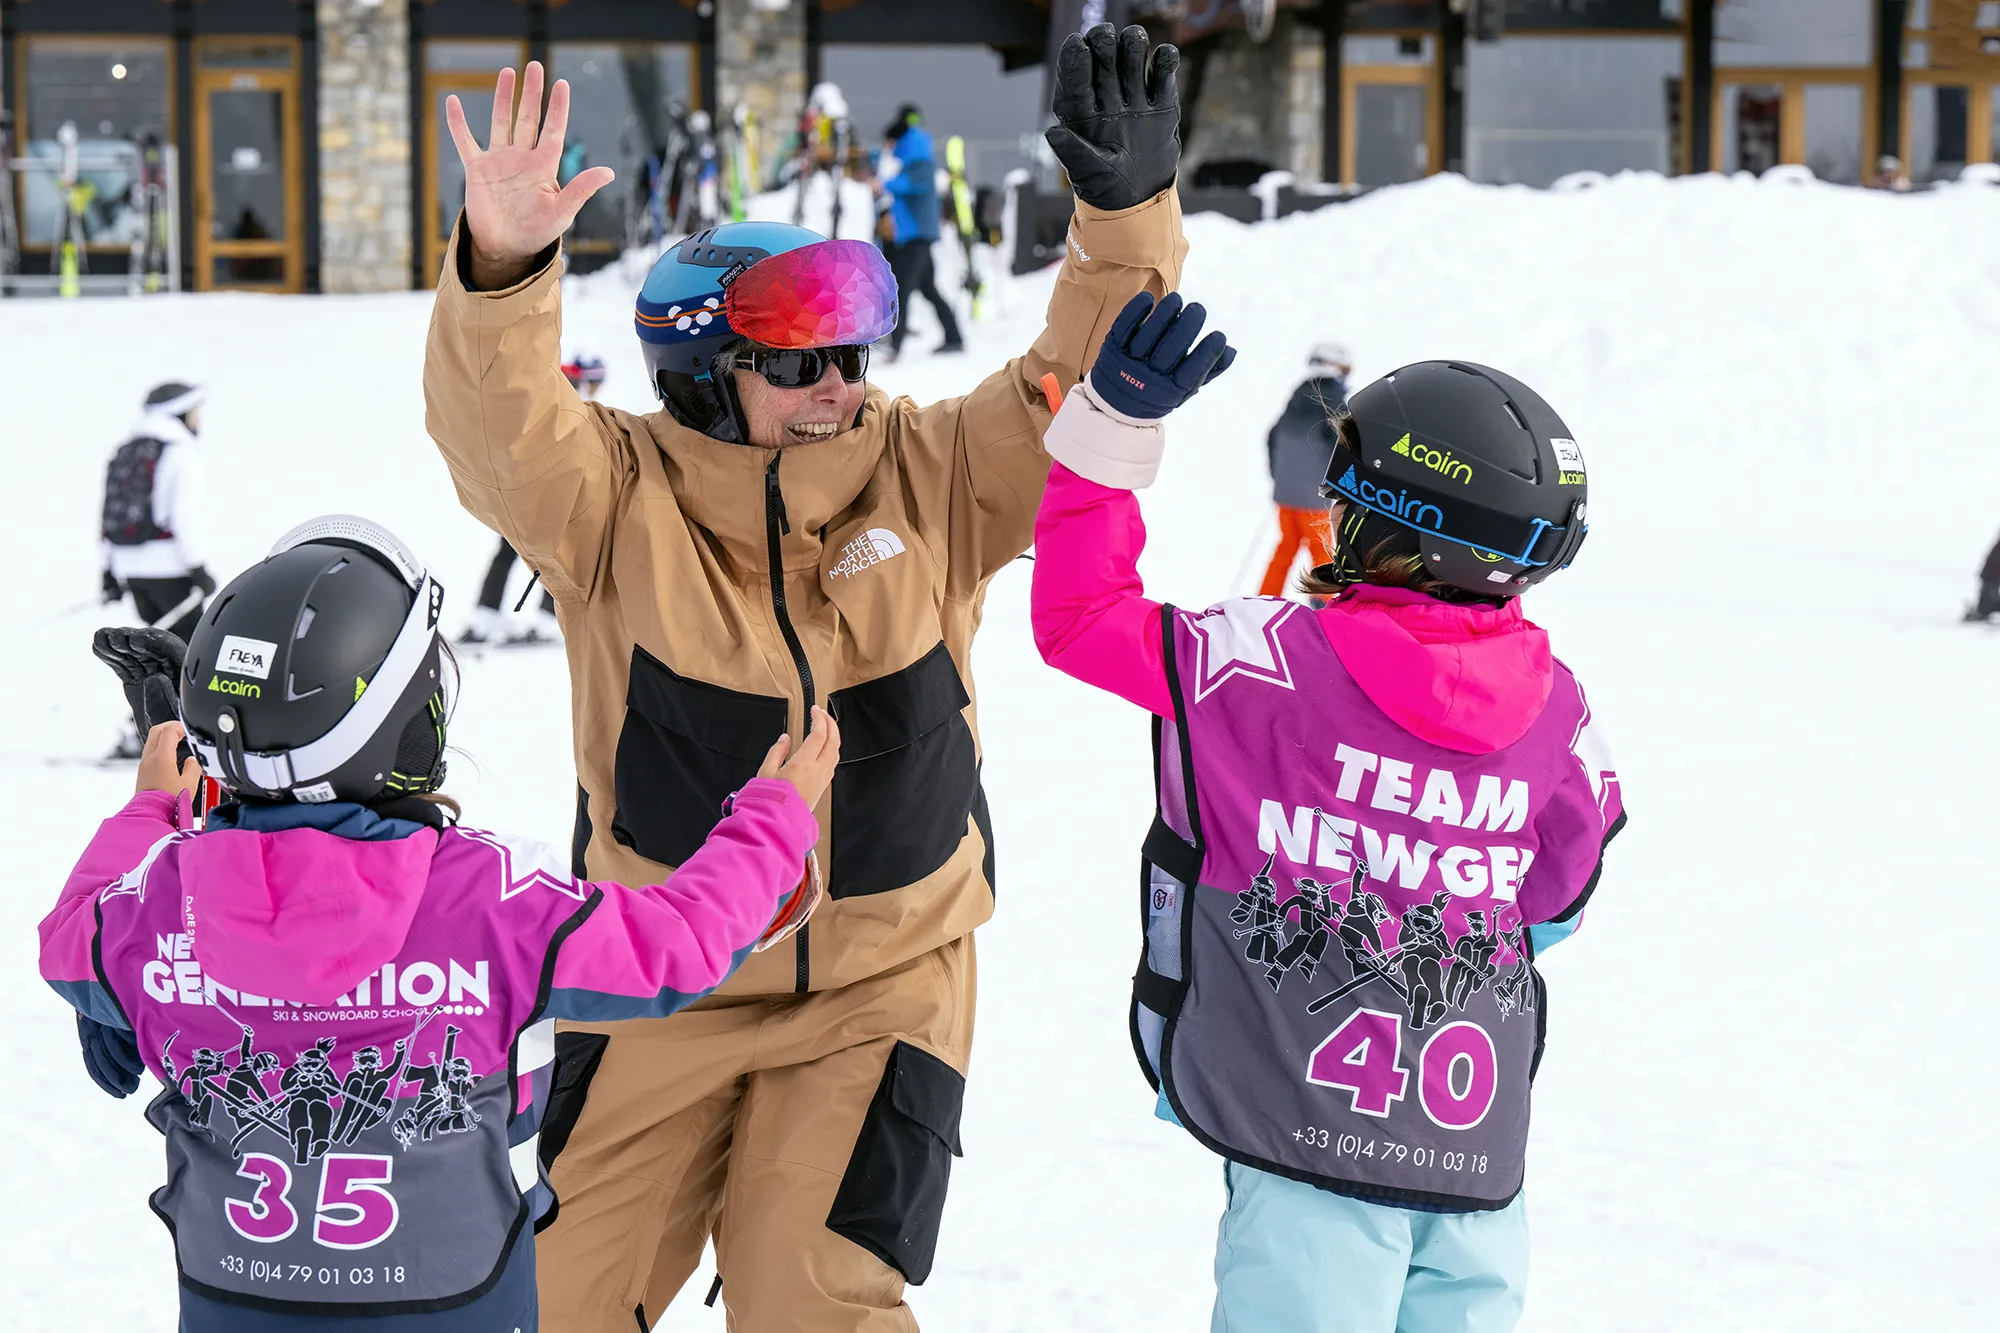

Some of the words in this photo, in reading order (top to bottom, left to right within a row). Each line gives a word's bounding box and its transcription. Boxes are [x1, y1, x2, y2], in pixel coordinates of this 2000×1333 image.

[1120, 370, 1145, 390] WEDZE
[1411, 444, 1473, 485] cairn
[1359, 480, 1444, 530] cairn
[828, 542, 875, 580] NORTH
[841, 533, 869, 555] THE
[843, 553, 880, 579] FACE
[229, 648, 264, 669] FREYA
[220, 679, 261, 699] cairn
[1333, 742, 1529, 833] TEAM
[156, 932, 193, 962] NE
[142, 957, 490, 1008] GENTION
[273, 1010, 289, 1021] SKI
[291, 1011, 300, 1021] &
[302, 1009, 379, 1022] SNOWBOARD
[382, 1007, 430, 1019] SCHOOL
[1305, 1006, 1499, 1131] 40
[1292, 1126, 1330, 1149] +33
[1336, 1133, 1375, 1160] (0)4
[1380, 1141, 1408, 1163] 79
[1413, 1147, 1435, 1168] 01
[1442, 1151, 1465, 1171] 03
[1471, 1154, 1488, 1174] 18
[224, 1152, 400, 1251] 35
[219, 1255, 244, 1274] +33
[250, 1260, 282, 1283] (0)4
[288, 1264, 313, 1282] 79
[318, 1267, 340, 1285] 01
[349, 1267, 374, 1285] 03
[383, 1266, 406, 1284] 18
